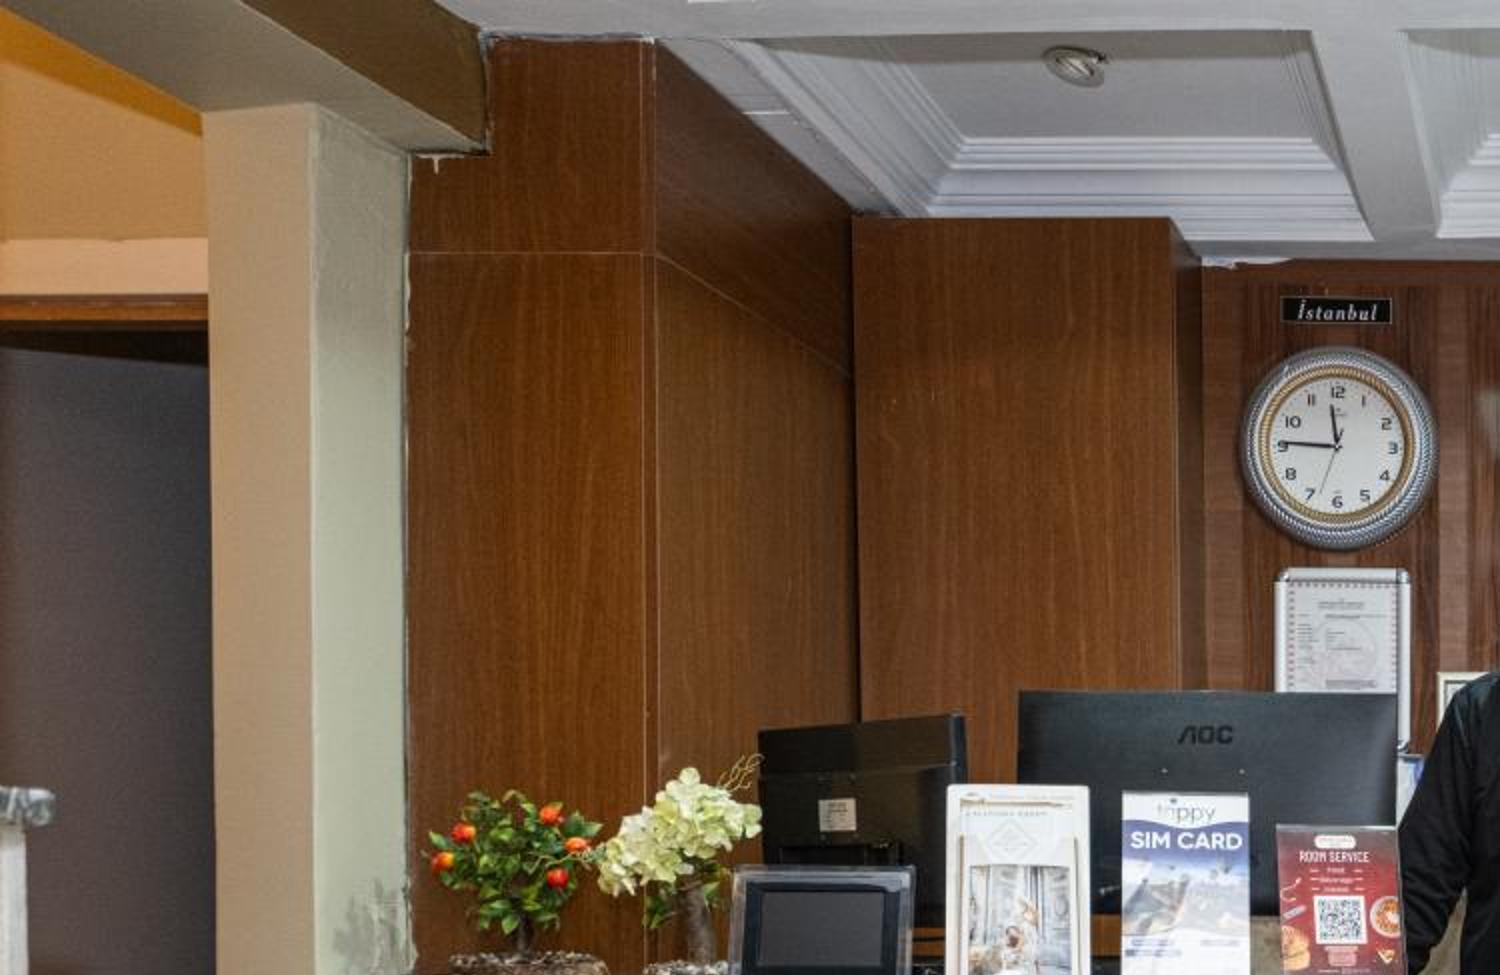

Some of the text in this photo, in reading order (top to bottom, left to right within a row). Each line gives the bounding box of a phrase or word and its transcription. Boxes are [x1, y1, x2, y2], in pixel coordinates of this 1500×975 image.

[1331, 386, 1345, 399] 12
[1307, 394, 1315, 406] 11
[1361, 395, 1365, 407] 1
[1285, 415, 1301, 428] 10
[1381, 417, 1392, 430] 2
[1388, 442, 1398, 454] 3
[1285, 467, 1296, 480] 8
[1379, 470, 1390, 481] 4
[1305, 488, 1315, 500] 7
[1360, 489, 1371, 501] 5
[1332, 495, 1343, 508] 6
[1177, 725, 1233, 745] AOC
[1130, 831, 1243, 850] SIM CARD
[1299, 851, 1370, 863] ROOM SERVICE
